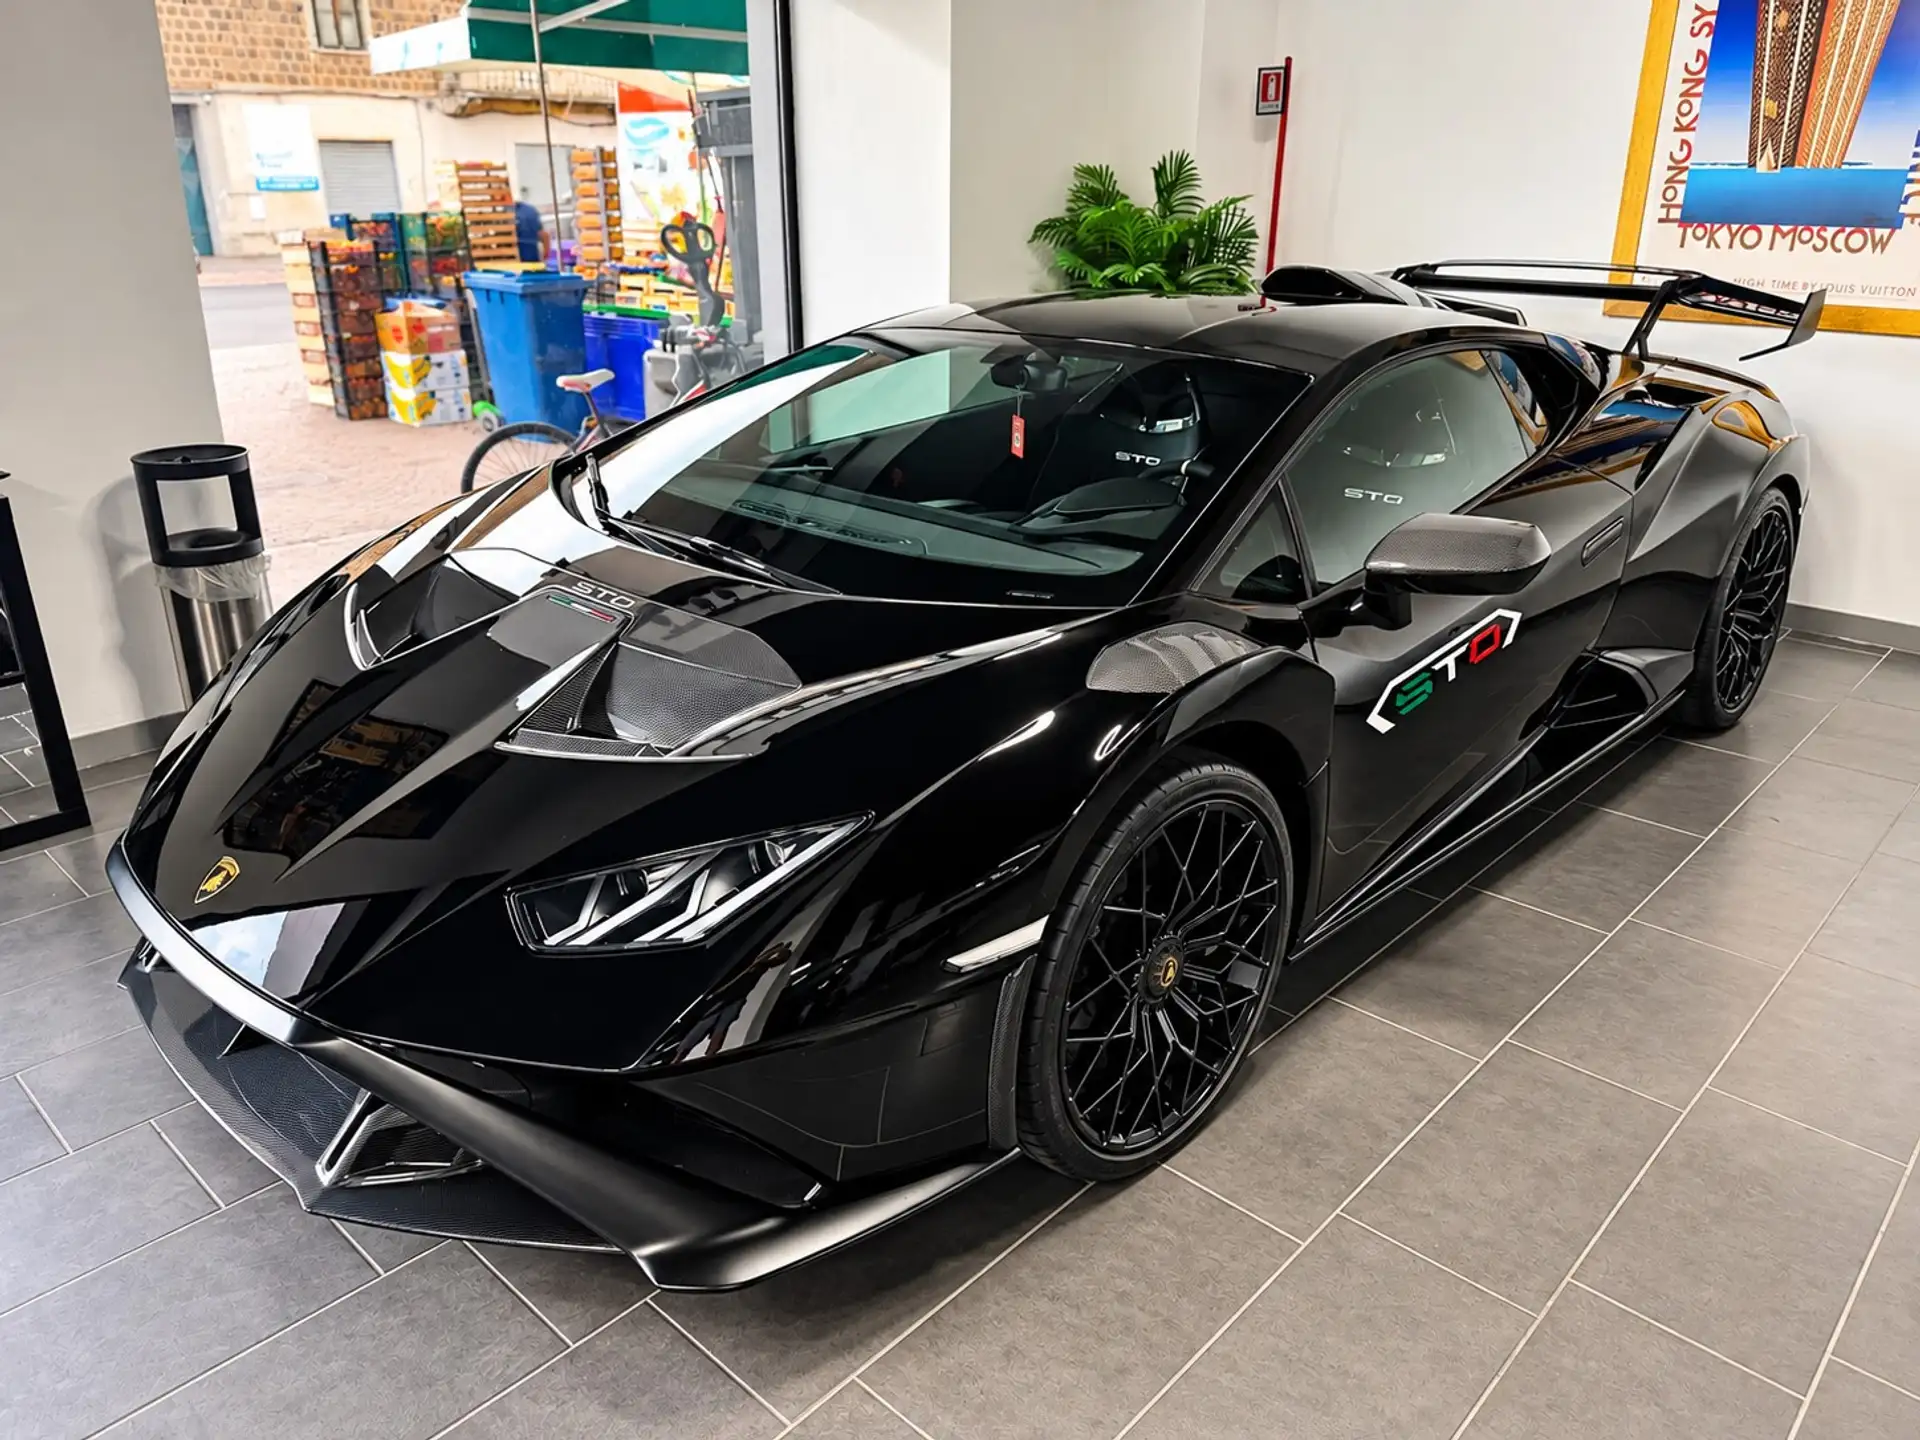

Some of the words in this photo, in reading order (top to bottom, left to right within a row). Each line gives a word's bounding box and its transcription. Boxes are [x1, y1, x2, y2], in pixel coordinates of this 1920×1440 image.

[1673, 49, 1709, 132] KONG
[1658, 138, 1693, 223] HONG
[1677, 223, 1763, 250] TOKYO
[1769, 224, 1896, 255] MOSCOW
[1771, 279, 1799, 291] TIME
[1860, 284, 1917, 297] VUITTON
[1115, 450, 1161, 466] STO
[1344, 487, 1403, 504] STO
[571, 581, 636, 609] STO
[1395, 623, 1502, 715] STO
